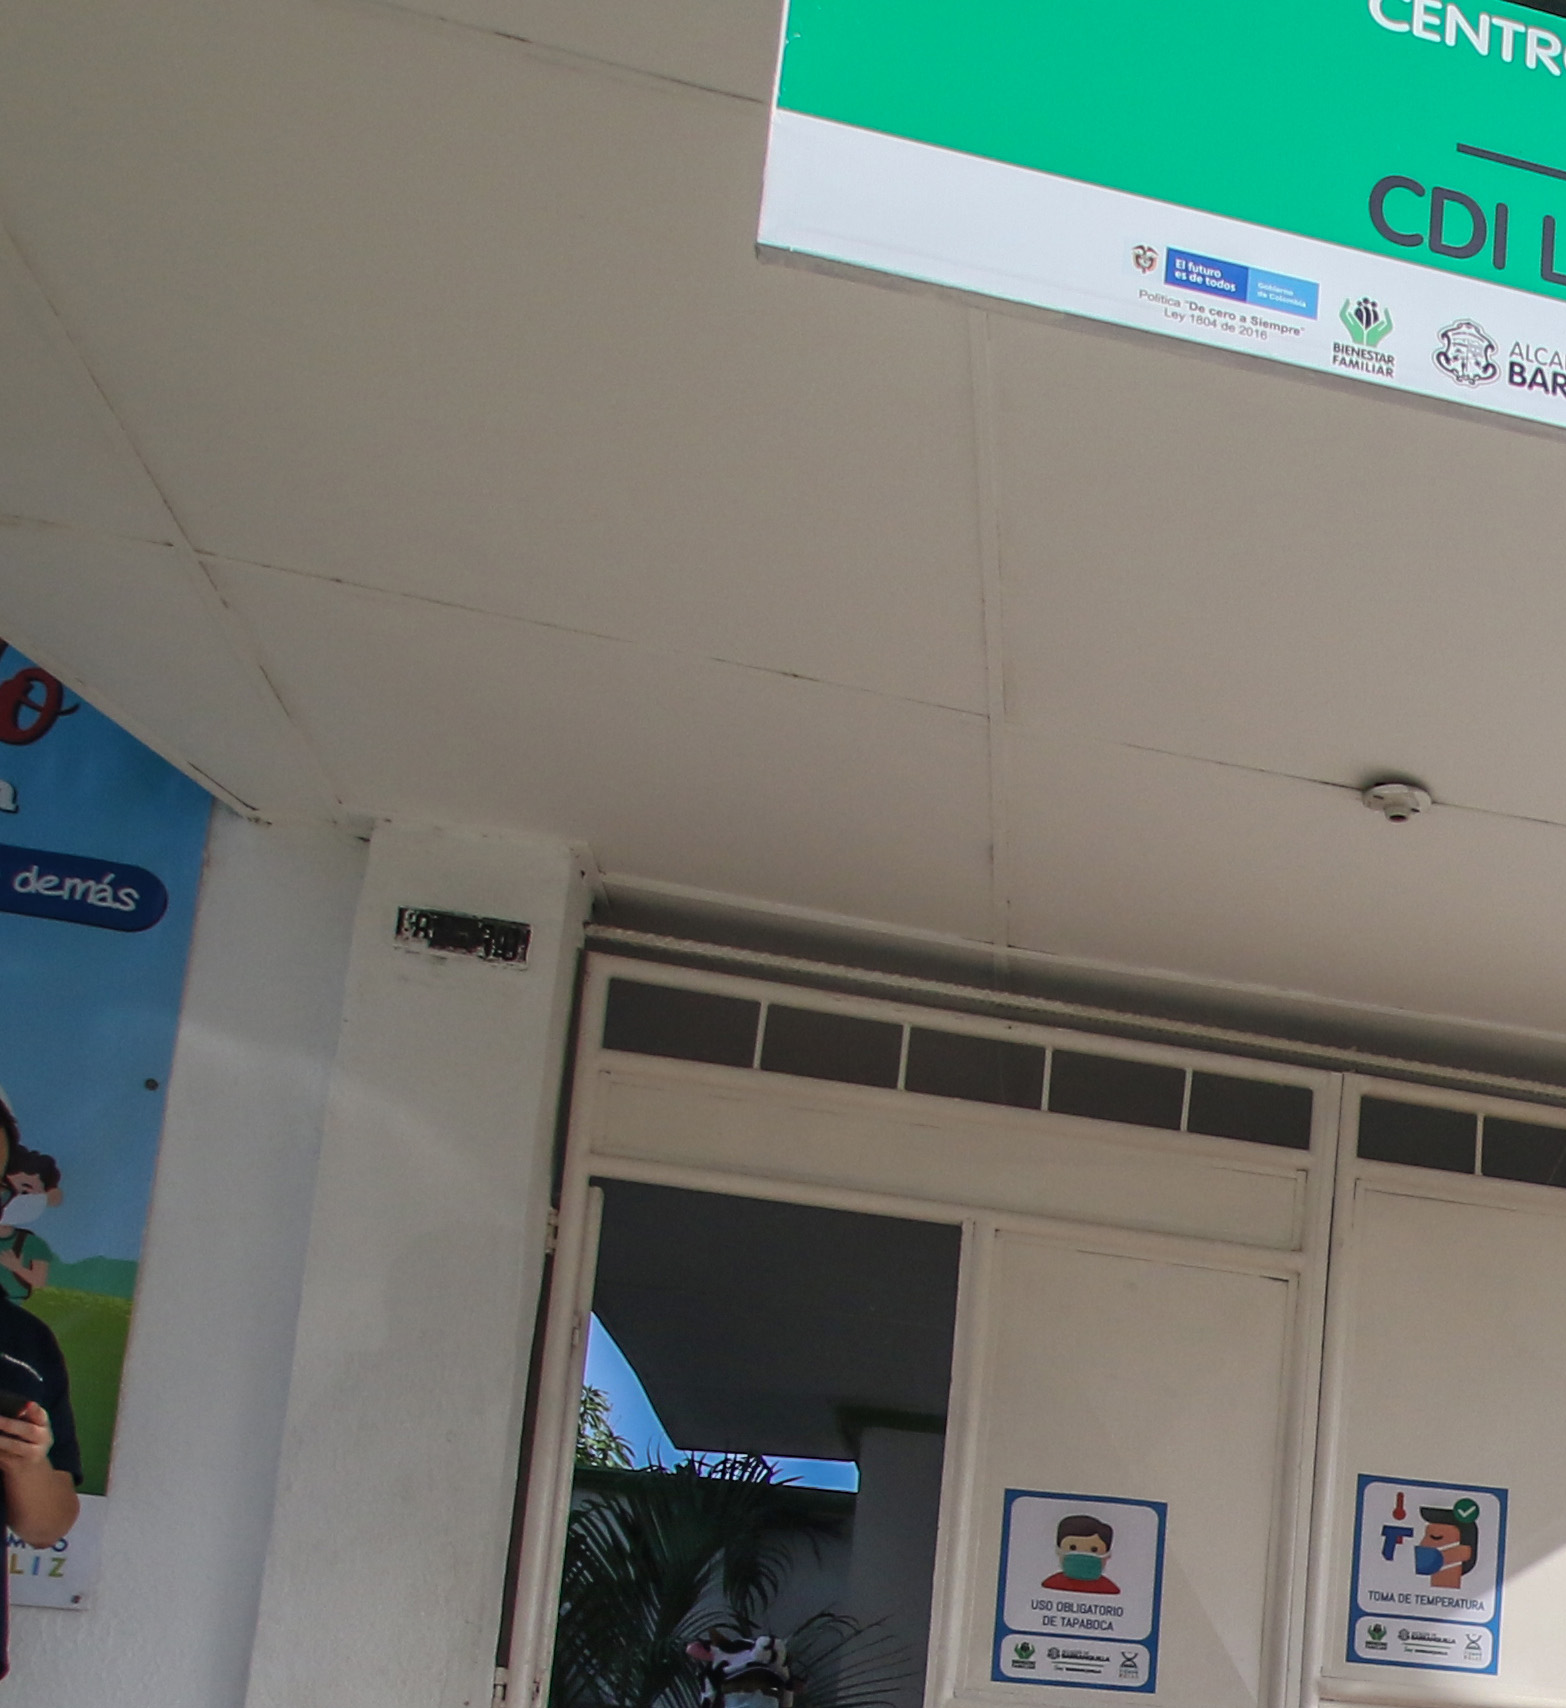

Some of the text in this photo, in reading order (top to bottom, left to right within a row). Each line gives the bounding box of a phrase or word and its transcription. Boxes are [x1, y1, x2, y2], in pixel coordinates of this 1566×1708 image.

[1368, 175, 1508, 270] CDI
[1174, 258, 1222, 279] El futuro
[1174, 270, 1237, 292] es de todos
[1164, 308, 1269, 341] Ley 1804 de 2016
[1209, 306, 1236, 322] cero
[1332, 341, 1396, 366] BIENESTAR
[1331, 354, 1395, 378] FAMILIAR
[12, 864, 141, 913] demás
[1031, 1599, 1124, 1618] USO OBLIGATORIO
[1367, 1589, 1486, 1612] TOMA DE TEMPERATURA
[1042, 1615, 1115, 1632] DE TAPABOCA
